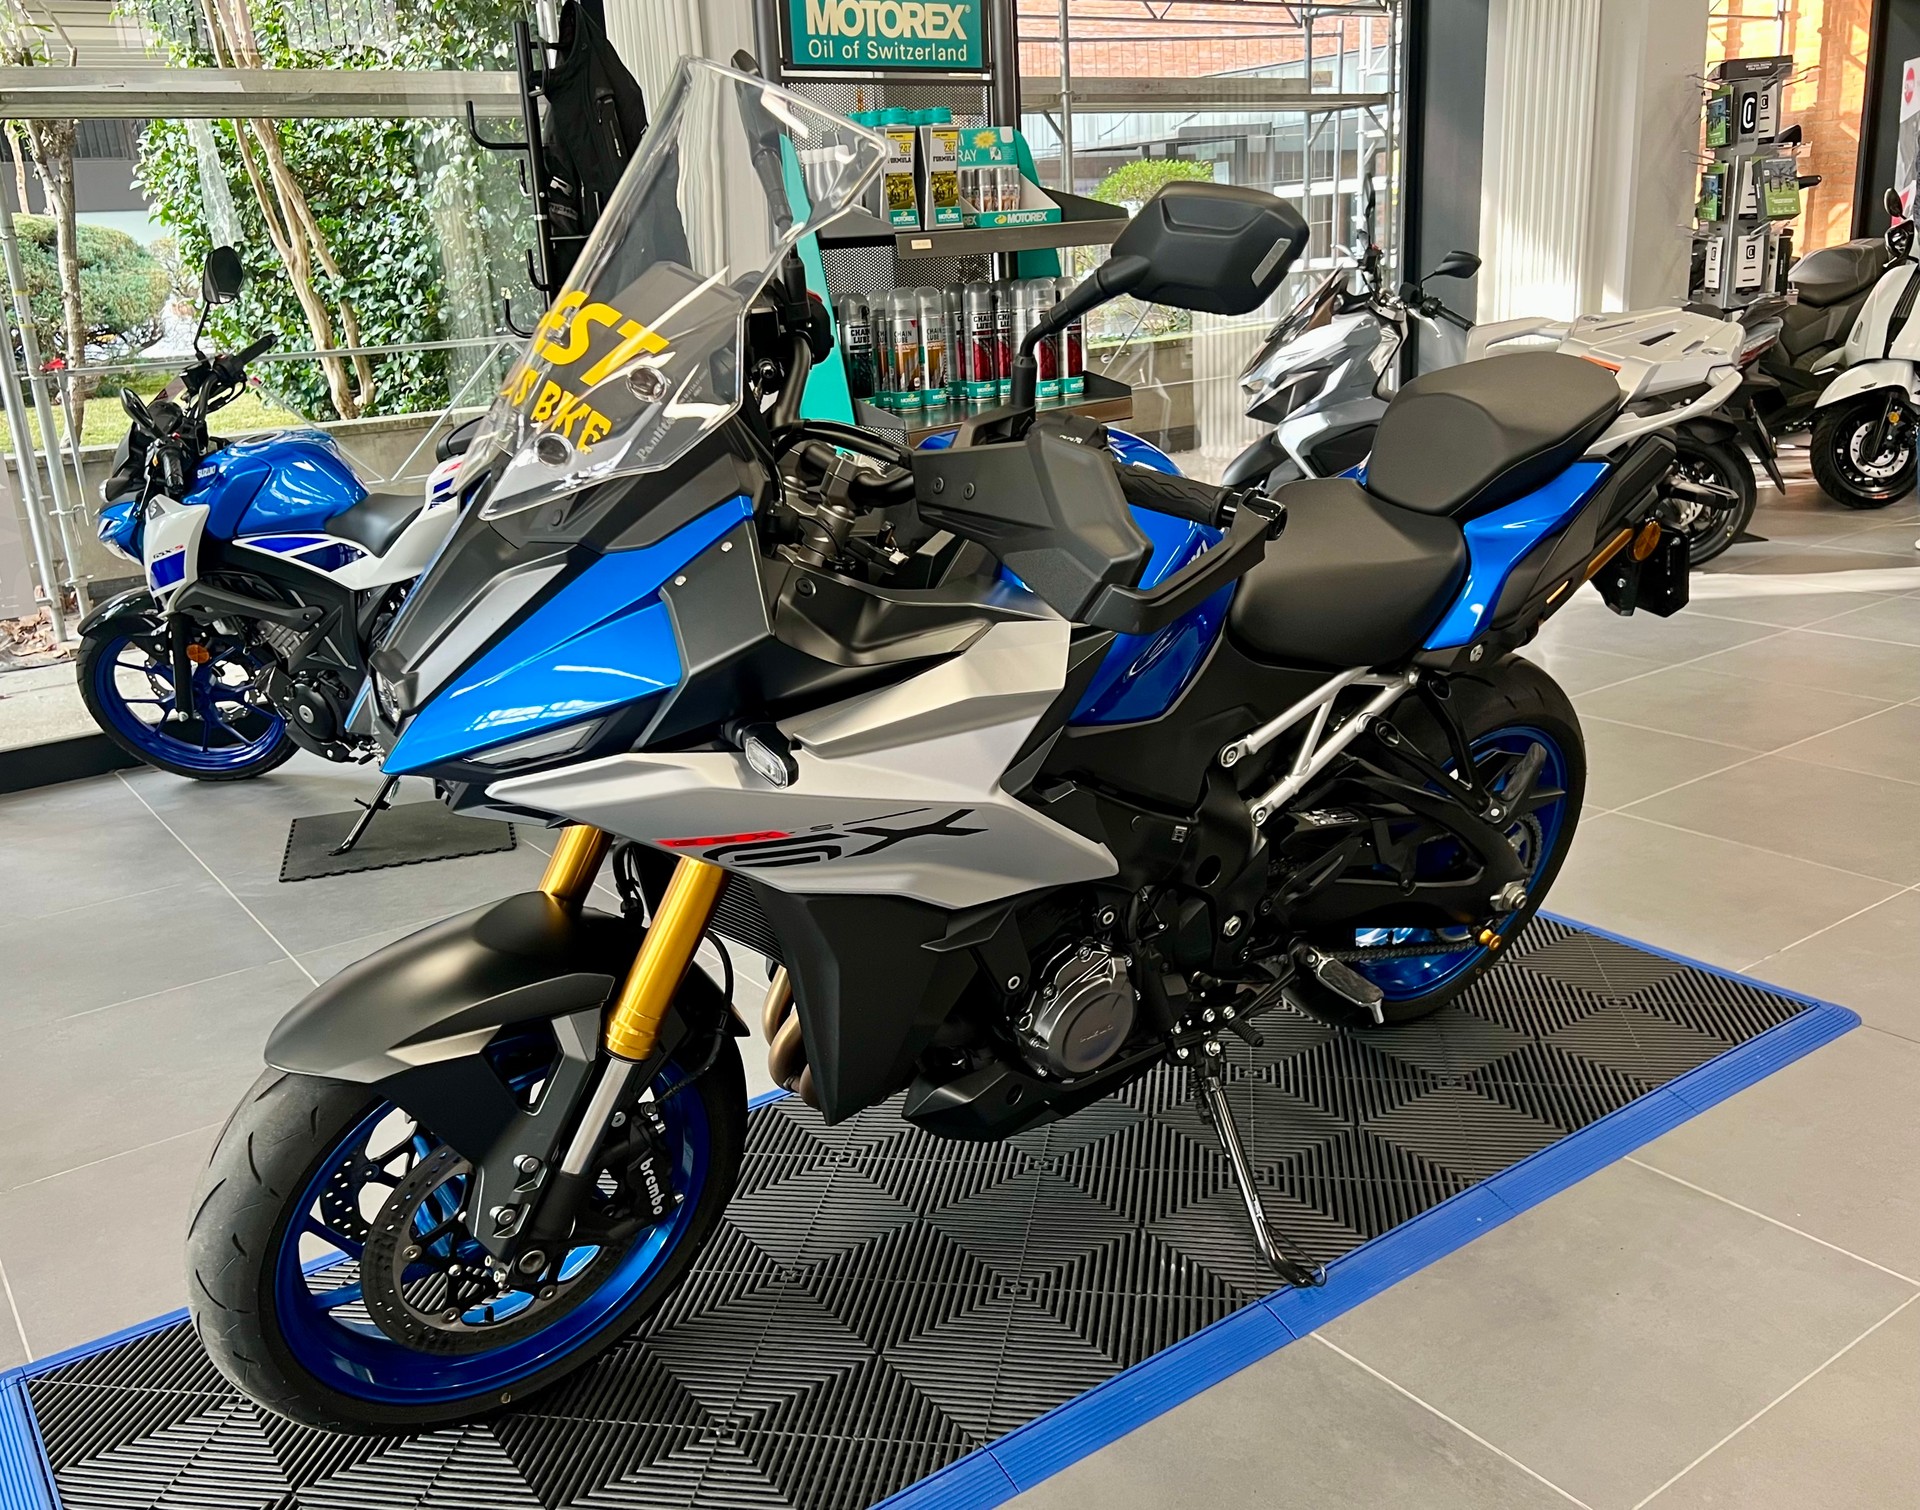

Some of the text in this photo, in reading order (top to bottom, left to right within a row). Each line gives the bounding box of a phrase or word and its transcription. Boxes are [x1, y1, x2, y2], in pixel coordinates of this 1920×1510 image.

[805, 0, 968, 40] MOTOREX
[808, 39, 967, 62] Oil of Switzerland
[1007, 211, 1048, 224] MOTOREX
[640, 1157, 666, 1216] brembo
